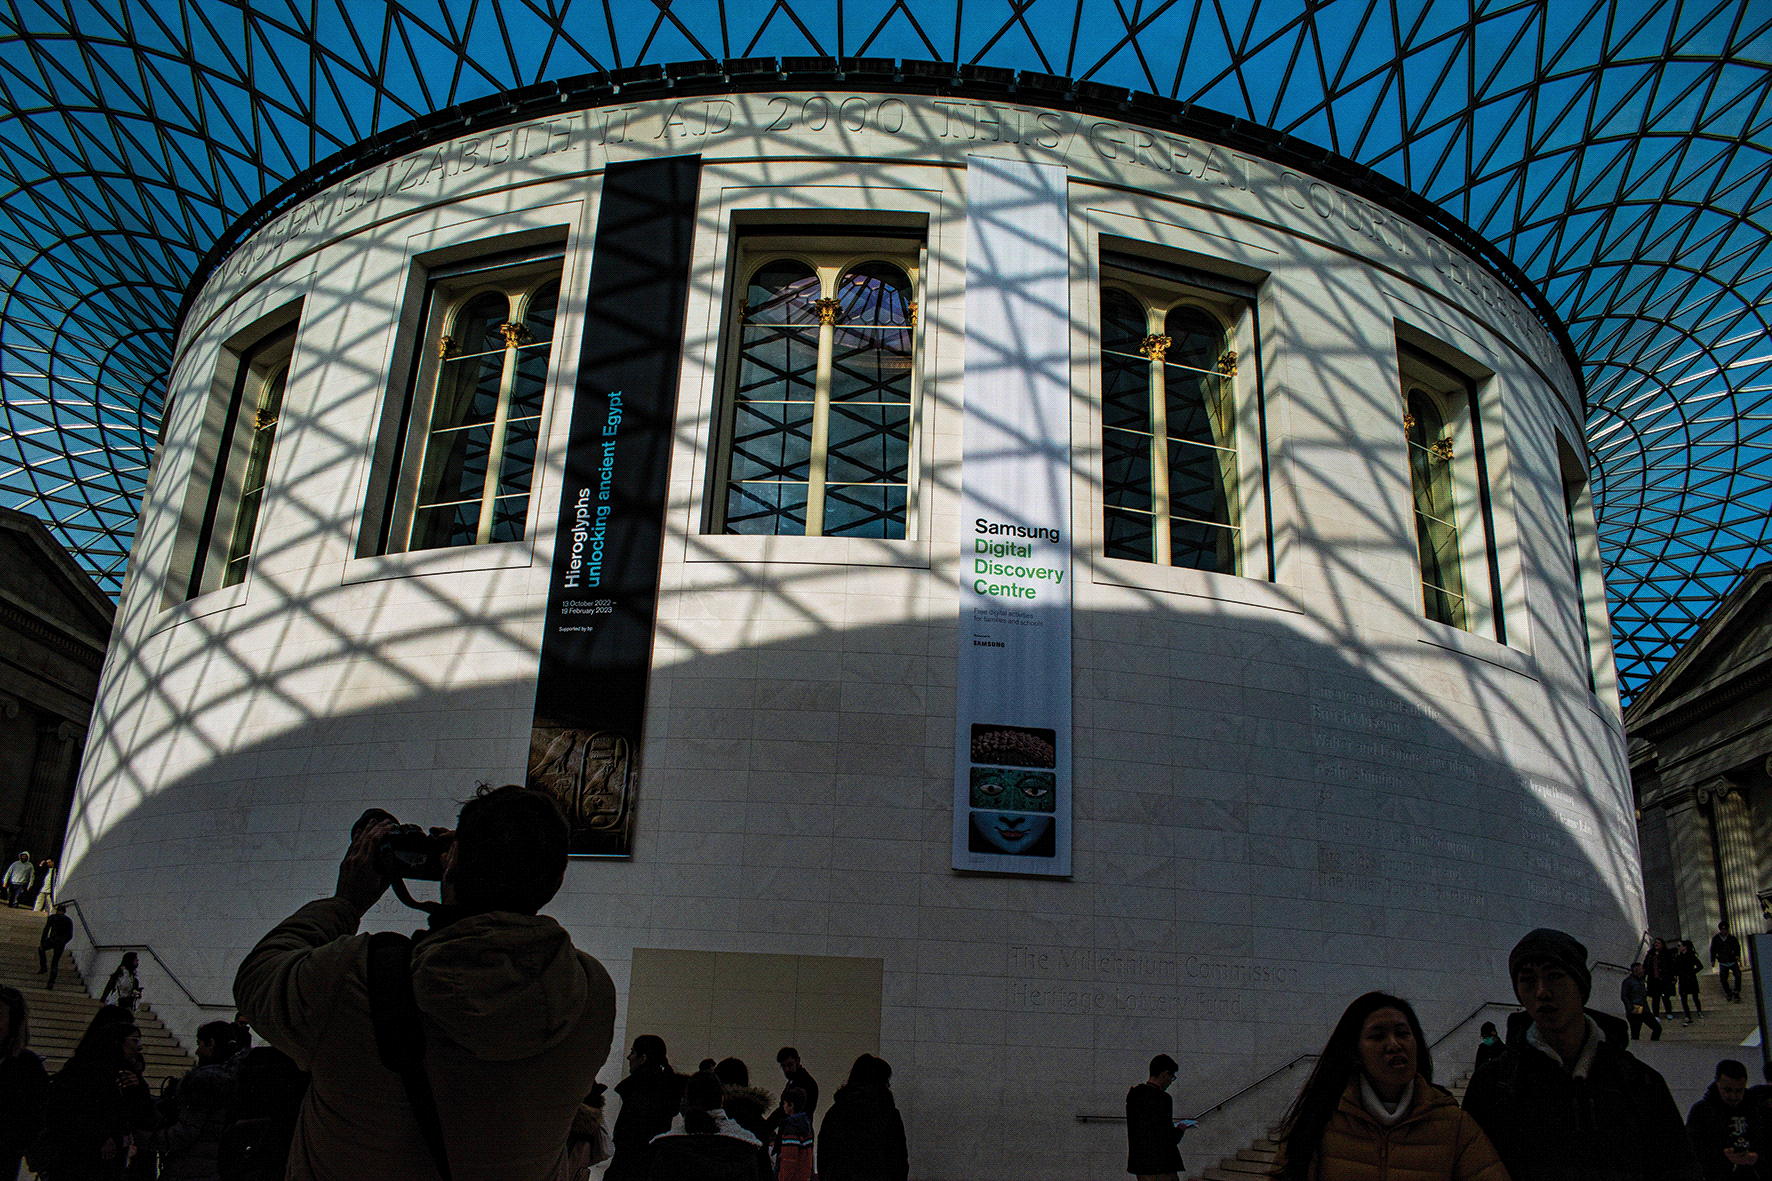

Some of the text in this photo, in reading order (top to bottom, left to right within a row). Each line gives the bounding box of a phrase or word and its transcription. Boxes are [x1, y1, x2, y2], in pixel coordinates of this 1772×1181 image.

[238, 191, 331, 277] QUEEN
[338, 114, 580, 216] ELIZABETH
[597, 107, 636, 146] II
[655, 98, 735, 140] AD
[765, 95, 909, 134] 2000
[934, 99, 1066, 150] THIS
[1089, 120, 1259, 194] GREAT
[1280, 171, 1410, 256] COURT
[588, 389, 623, 588] unlocking ancient Egypt
[563, 487, 591, 589] Hieroglyphs
[975, 518, 1060, 543] Samsung
[975, 538, 1032, 558] Digital
[974, 558, 1064, 584] Discovery
[974, 579, 1036, 599] Centre
[569, 607, 595, 615] February
[595, 606, 613, 614] 2023
[594, 599, 611, 607] 2022
[974, 607, 988, 615] Free
[988, 608, 1008, 617] digital
[1020, 619, 1043, 627] schools
[973, 640, 1005, 648] SAMSUNG
[1010, 945, 1300, 984] The Millennium Commission
[1011, 982, 1243, 1016] Heritage Lottery Fund
